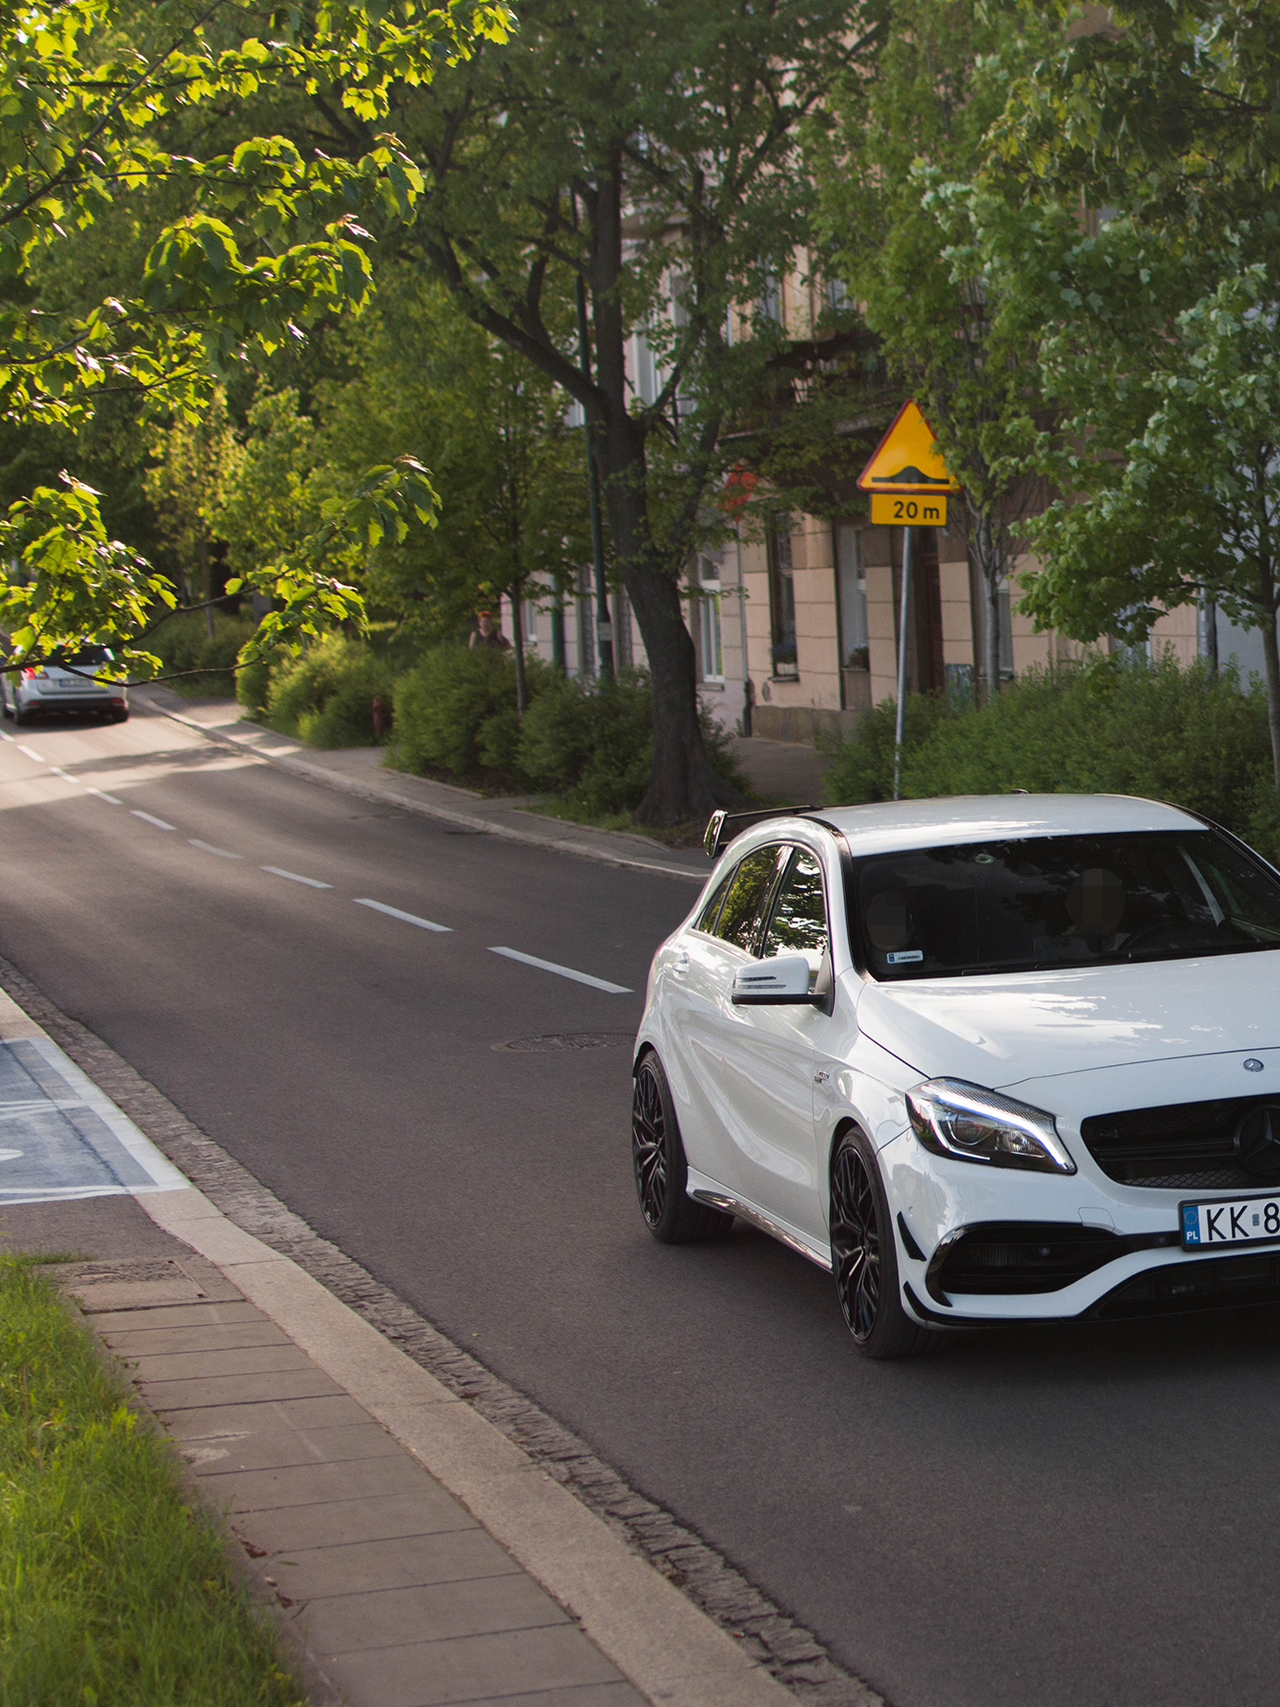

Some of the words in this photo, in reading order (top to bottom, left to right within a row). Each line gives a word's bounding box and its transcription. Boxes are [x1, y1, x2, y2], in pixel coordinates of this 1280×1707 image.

[893, 501, 918, 519] 20
[923, 507, 940, 519] m
[1186, 1231, 1198, 1241] PL
[1206, 1205, 1250, 1241] KK
